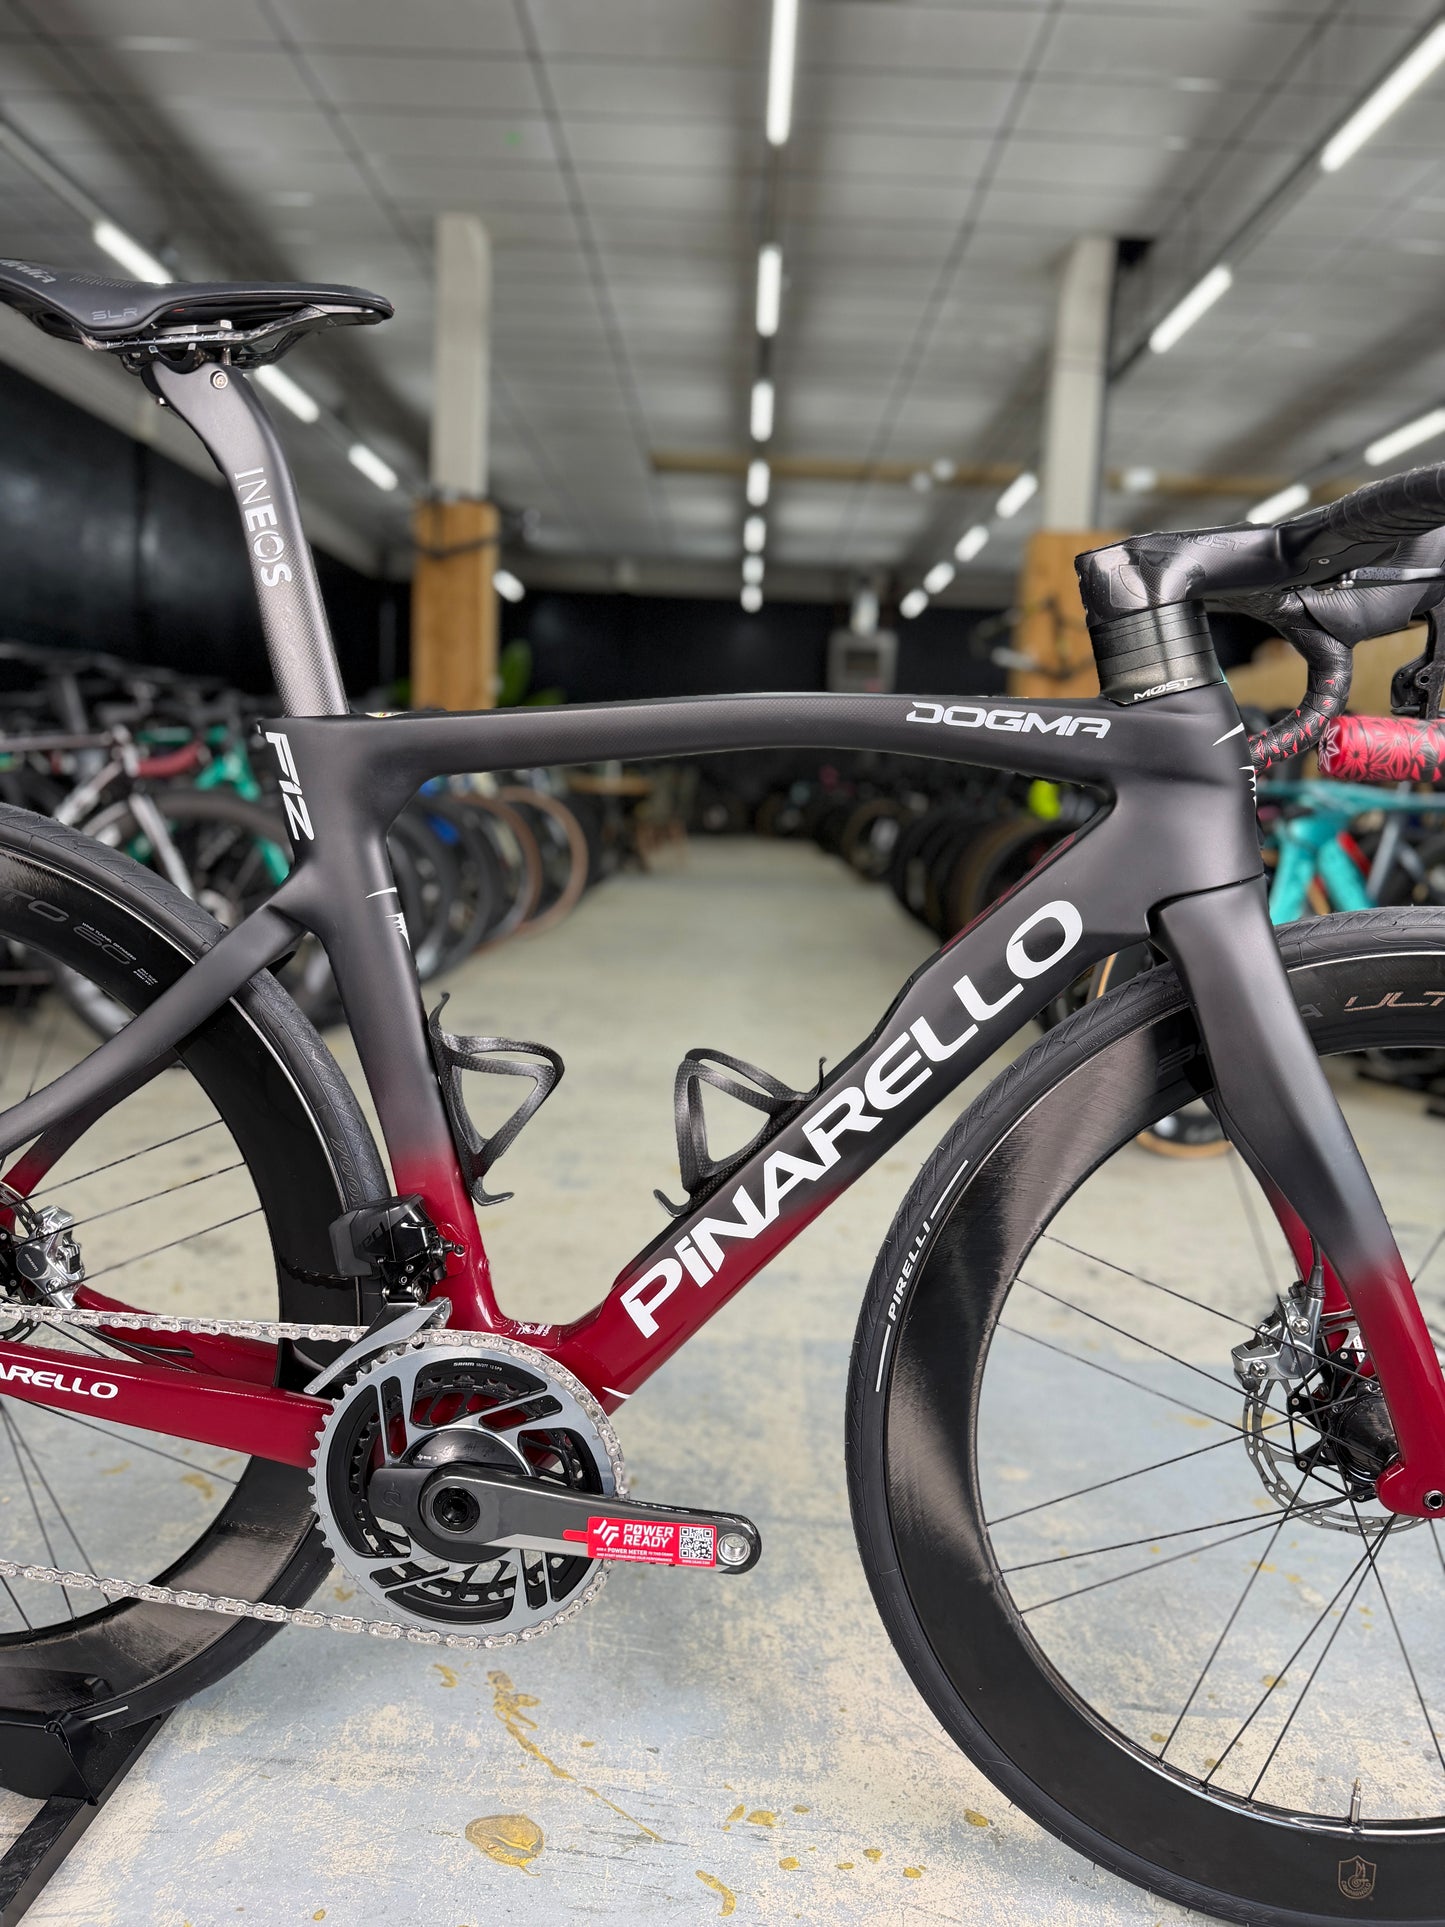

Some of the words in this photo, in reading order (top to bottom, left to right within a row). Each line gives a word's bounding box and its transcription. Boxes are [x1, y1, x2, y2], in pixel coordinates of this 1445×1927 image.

[91, 308, 138, 321] SLR
[234, 466, 292, 587] INEOS
[906, 701, 1112, 739] DOGMA
[265, 731, 315, 841] F12
[619, 900, 1083, 1340] PINARELLO
[887, 1220, 931, 1322] PIRELLI
[623, 1523, 675, 1538] POWER
[623, 1534, 670, 1549] READY
